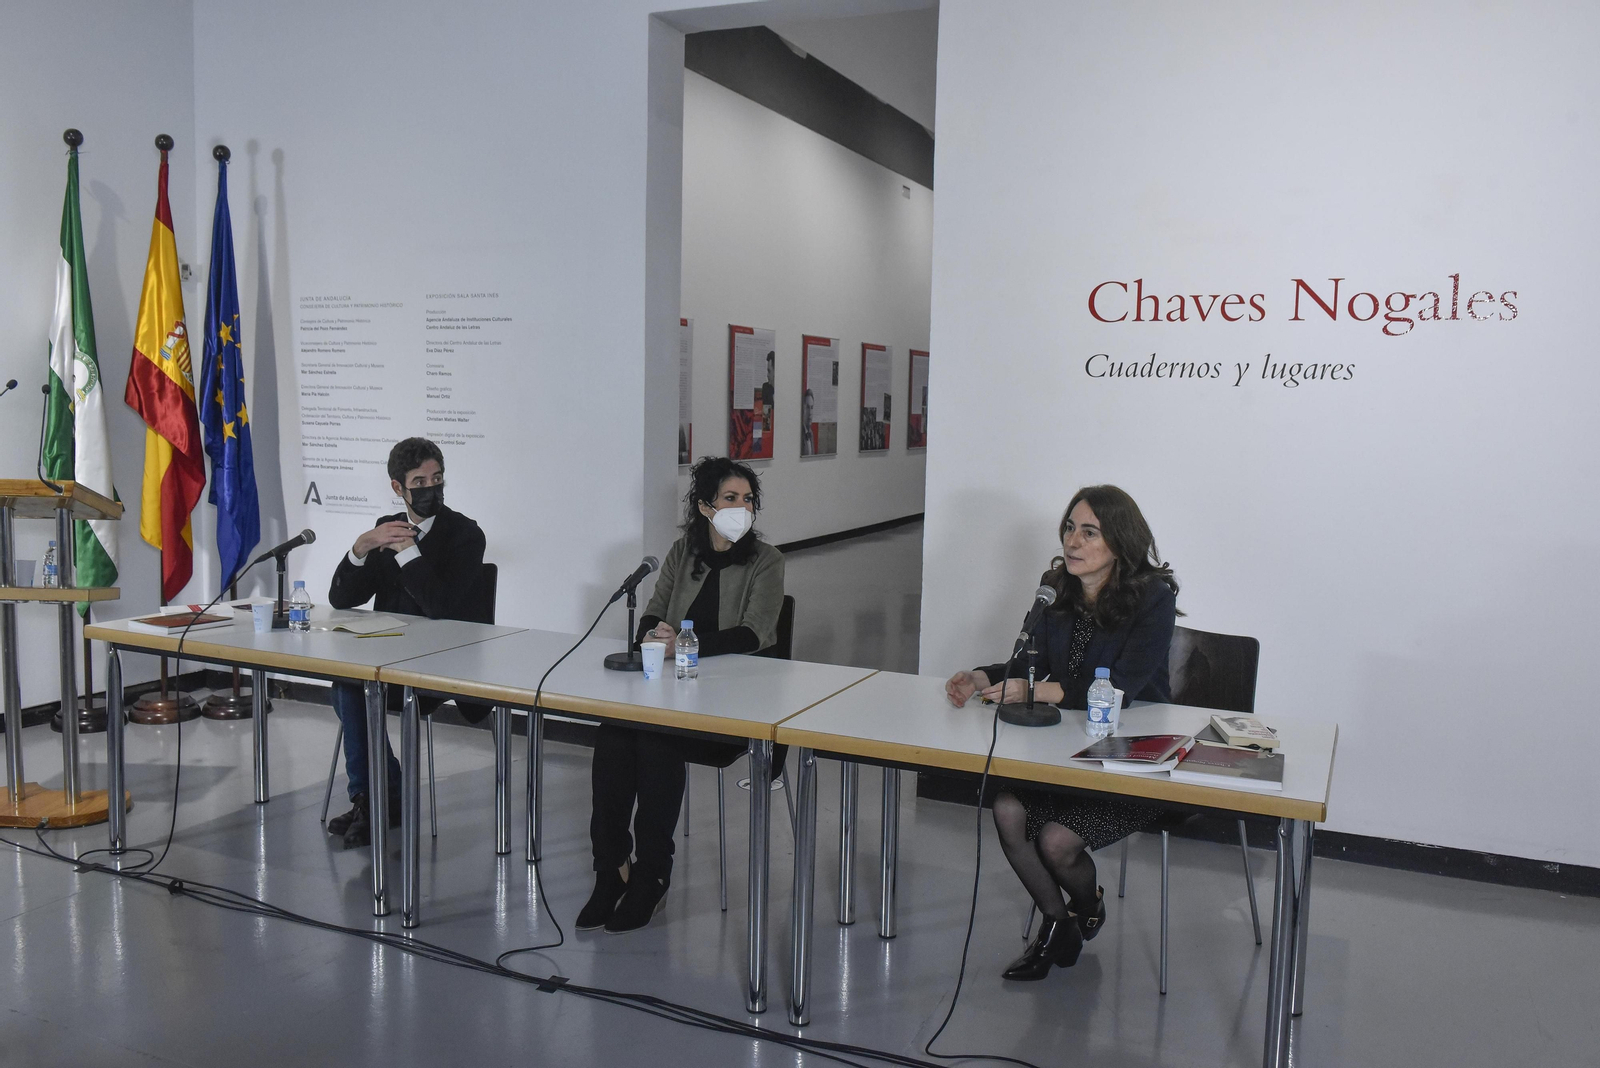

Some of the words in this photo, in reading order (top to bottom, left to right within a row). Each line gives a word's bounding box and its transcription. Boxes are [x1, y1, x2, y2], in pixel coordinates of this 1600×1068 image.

[1088, 278, 1266, 323] Chaves
[1288, 273, 1518, 337] Nogales
[1085, 352, 1222, 378] Cuadernos
[1232, 361, 1250, 387] y
[1261, 353, 1356, 389] lugares
